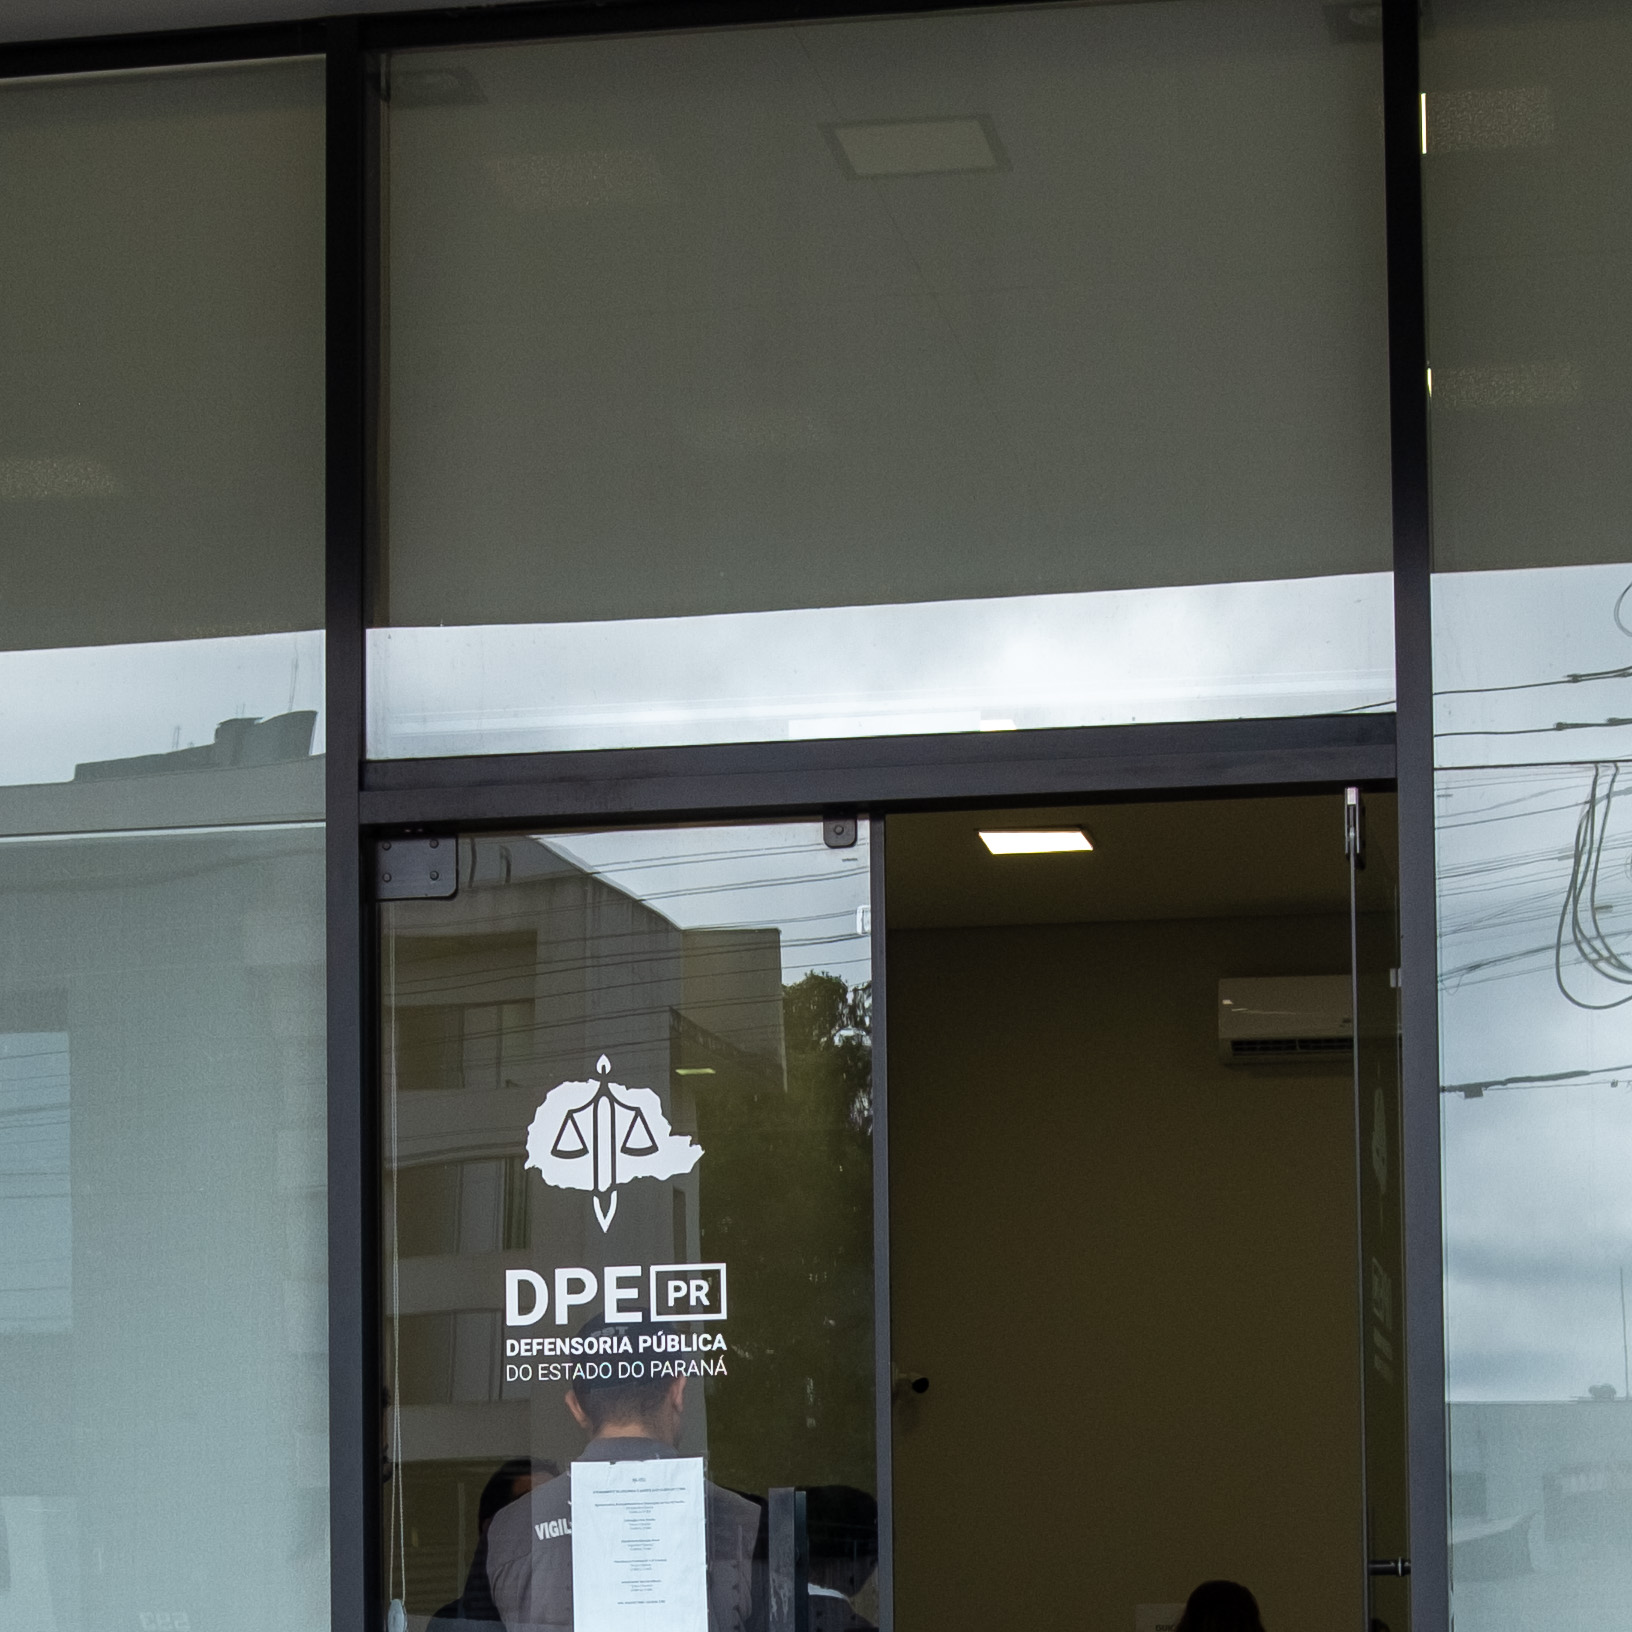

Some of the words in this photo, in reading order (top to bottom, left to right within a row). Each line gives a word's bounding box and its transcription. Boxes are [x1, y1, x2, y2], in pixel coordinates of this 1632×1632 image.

[505, 1265, 643, 1327] DPE
[667, 1279, 711, 1307] PR
[506, 1336, 633, 1357] DEFENSORIA
[638, 1330, 728, 1352] PÚBLICA
[506, 1363, 533, 1382] DO
[538, 1361, 613, 1381] ESTADO
[618, 1360, 645, 1379] DO
[650, 1354, 728, 1379] PARANÁ
[534, 1518, 572, 1540] VIGIL
